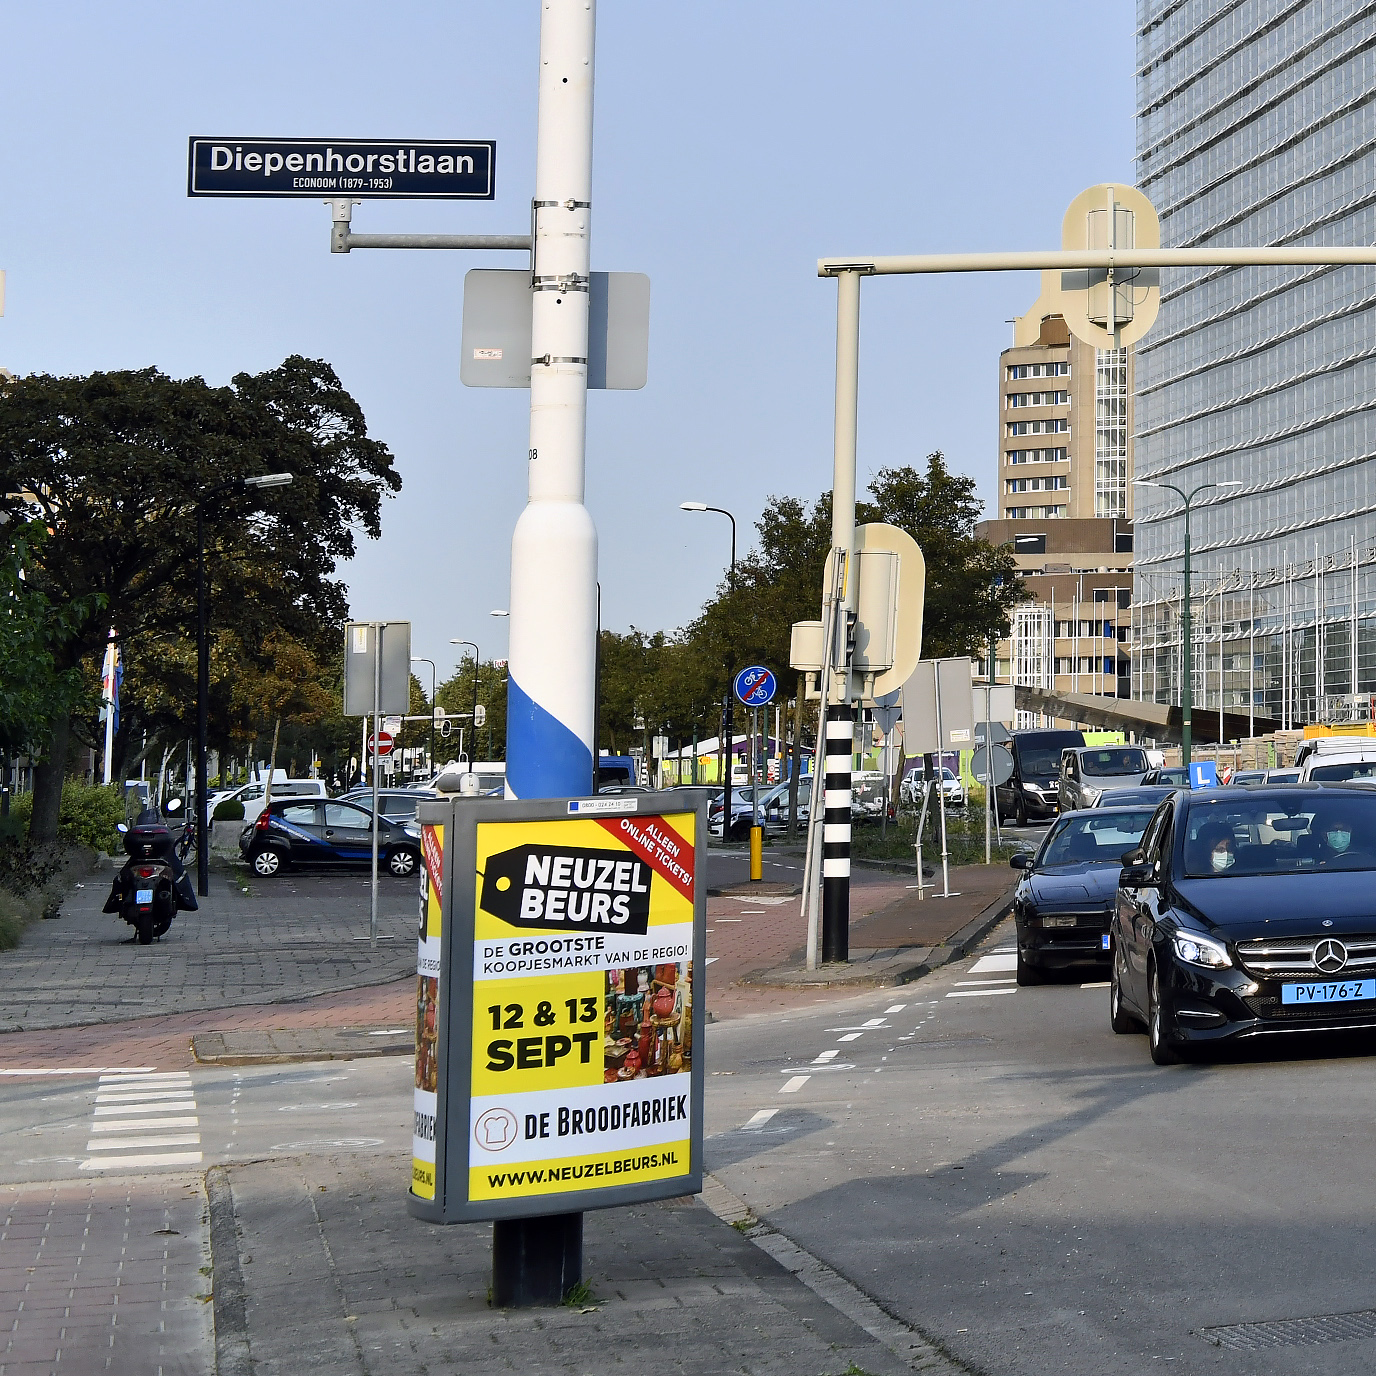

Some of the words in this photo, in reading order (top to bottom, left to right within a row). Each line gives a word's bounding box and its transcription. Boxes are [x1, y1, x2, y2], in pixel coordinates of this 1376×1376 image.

[210, 146, 474, 176] Diepenhorstlaan
[293, 177, 336, 188] ECONOOM
[338, 177, 393, 189] (1879-1953)
[1196, 766, 1211, 785] L
[620, 818, 654, 853] ONLINE
[655, 846, 693, 887] TICKETS!
[645, 823, 680, 858] ALLEEN
[524, 854, 648, 893] NEUZEL
[519, 888, 631, 925] BEURS
[483, 954, 601, 974] KOOPJESMARKT
[605, 951, 630, 964] VAN
[634, 948, 649, 961] DE
[652, 945, 688, 960] REGIO!
[484, 946, 504, 959] DE
[508, 936, 605, 957] GROOTSTE
[1296, 983, 1363, 1000] PV-176-Z
[487, 1003, 524, 1031] 12
[533, 1000, 557, 1027] &
[565, 996, 598, 1024] 13
[485, 1031, 598, 1072] SEPT
[524, 1112, 550, 1140] DE
[557, 1094, 688, 1137] BROODFABRIEK
[488, 1151, 678, 1188] WWW.NEUZELBEURS.NL
